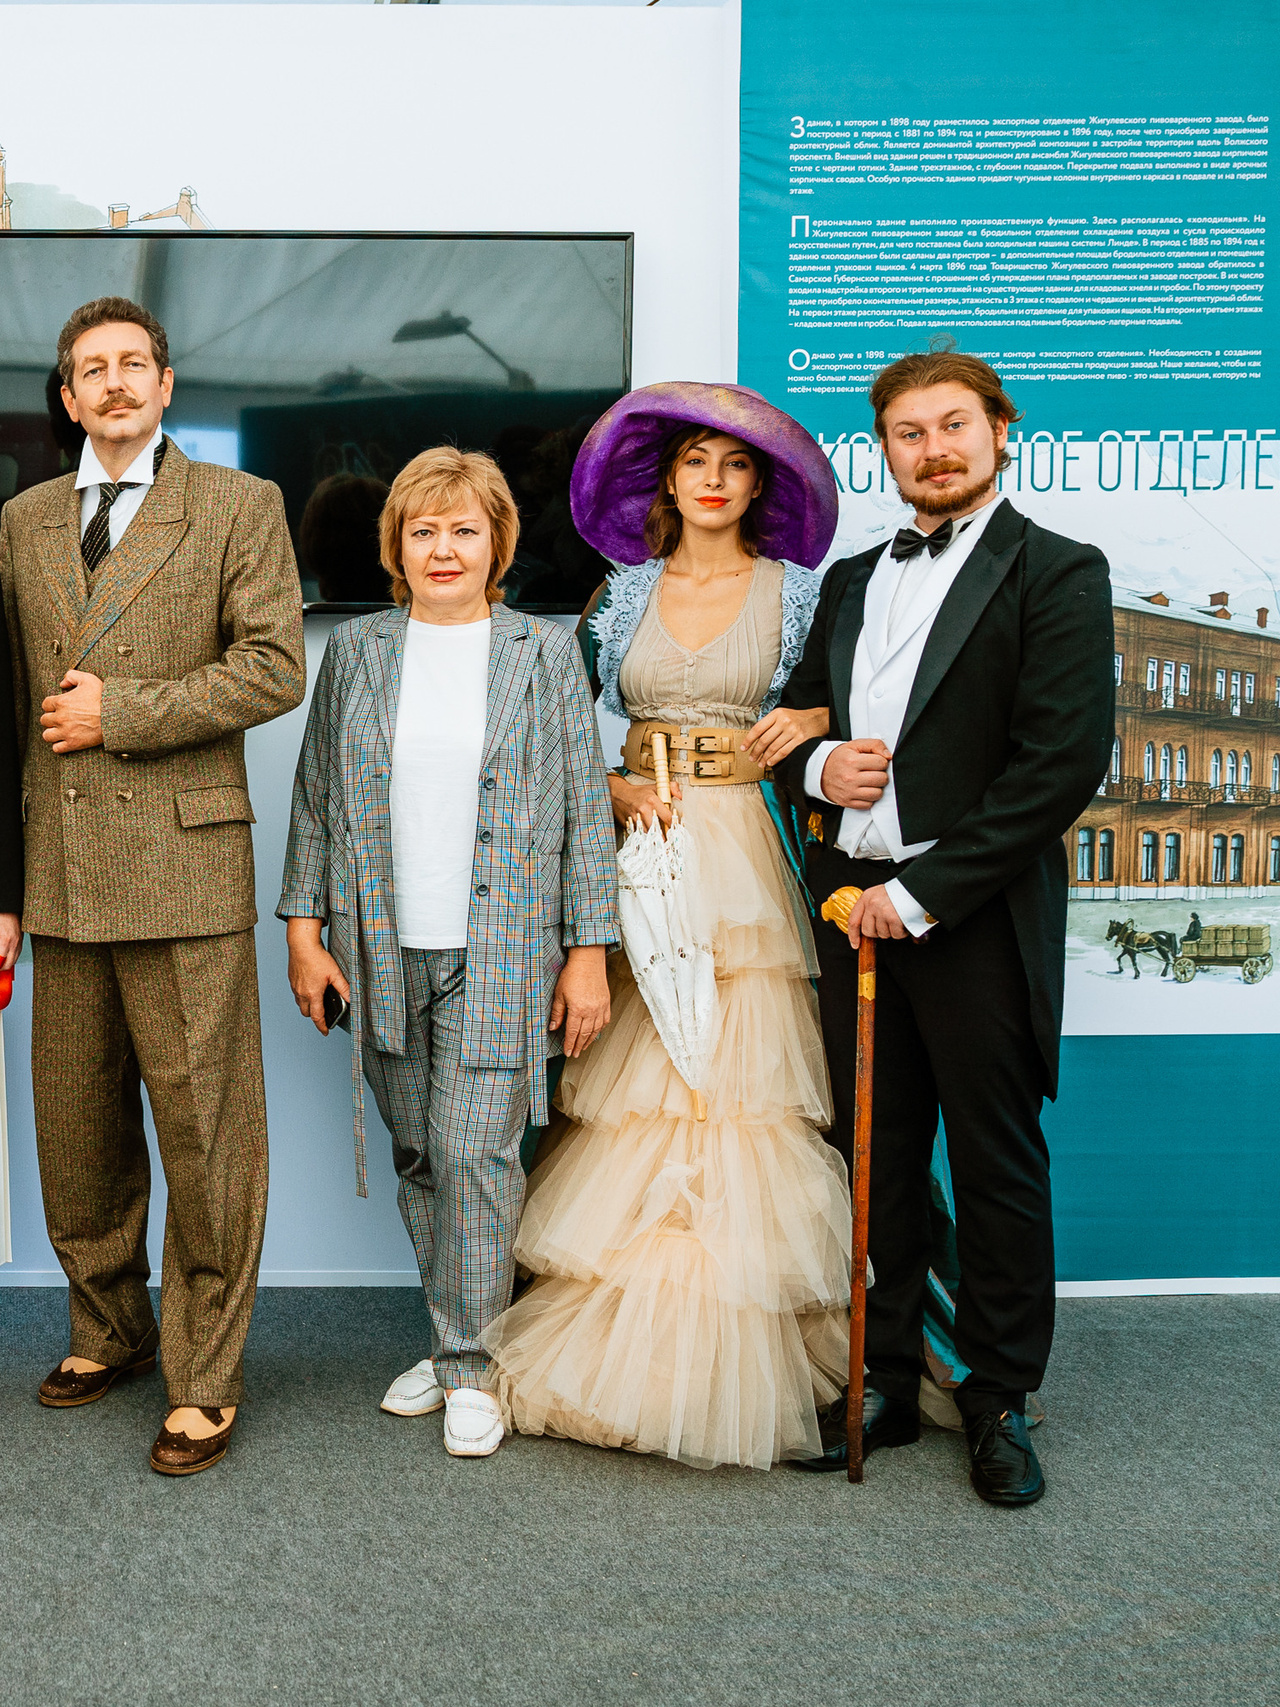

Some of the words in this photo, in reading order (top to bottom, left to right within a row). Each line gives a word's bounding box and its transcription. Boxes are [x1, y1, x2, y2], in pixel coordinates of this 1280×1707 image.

[843, 120, 878, 128] котором
[889, 117, 909, 126] 1898
[912, 119, 930, 128] году
[992, 118, 1040, 126] экспортное
[1042, 118, 1086, 126] отделение
[1246, 114, 1269, 123] было
[806, 131, 850, 140] построено
[861, 131, 892, 139] период
[902, 128, 920, 138] 1881
[936, 128, 956, 138] 1894
[959, 130, 973, 138] год
[1071, 127, 1091, 136] 1896
[1143, 128, 1162, 136] чего
[1164, 127, 1210, 136] приобрело
[1212, 125, 1268, 135] завершенный
[883, 140, 920, 149] Является
[922, 140, 972, 149] доминантой
[1100, 136, 1142, 147] застройке
[1145, 139, 1194, 148] территории
[1196, 139, 1221, 147] вдоль
[1224, 137, 1268, 146] Волжского
[834, 152, 872, 161] Внешний
[872, 153, 889, 161] вид
[890, 153, 918, 161] здания
[919, 153, 946, 161] решен
[1014, 152, 1030, 160] для
[1030, 150, 1069, 159] ансамбля
[1192, 150, 1220, 158] завода
[1221, 150, 1268, 158] кирпичном
[822, 165, 855, 173] чертами
[888, 163, 918, 172] Здание
[983, 162, 1021, 172] глубоким
[1066, 162, 1118, 171] Перекрытие
[1119, 162, 1153, 170] подвала
[1154, 162, 1200, 170] выполнено
[1232, 161, 1267, 170] арочных
[789, 177, 834, 185] кирпичных
[866, 174, 900, 184] Особую
[901, 176, 944, 184] прочность
[945, 175, 976, 183] зданию
[977, 175, 1013, 183] придают
[1013, 175, 1052, 184] чугунные
[1090, 174, 1141, 183] внутреннего
[1182, 173, 1216, 181] подвале
[1236, 173, 1267, 181] первом
[876, 219, 906, 227] здание
[1092, 215, 1117, 225] Здесь
[811, 229, 867, 239] Жигулевском
[935, 230, 964, 238] заводе
[980, 228, 1031, 238] бродильном
[1034, 229, 1079, 237] отделении
[1136, 228, 1170, 237] воздуха
[1182, 228, 1206, 237] сусла
[1209, 227, 1266, 236] происходило
[838, 352, 854, 361] уже
[865, 350, 884, 359] 1898
[1002, 351, 1036, 359] контора
[1223, 349, 1262, 357] создании
[991, 361, 1026, 370] объемов
[1084, 362, 1129, 370] продукции
[1160, 360, 1183, 368] Наше
[1221, 359, 1246, 368] чтобы
[816, 373, 846, 382] больше
[1212, 372, 1247, 380] которую
[787, 385, 811, 394] несём
